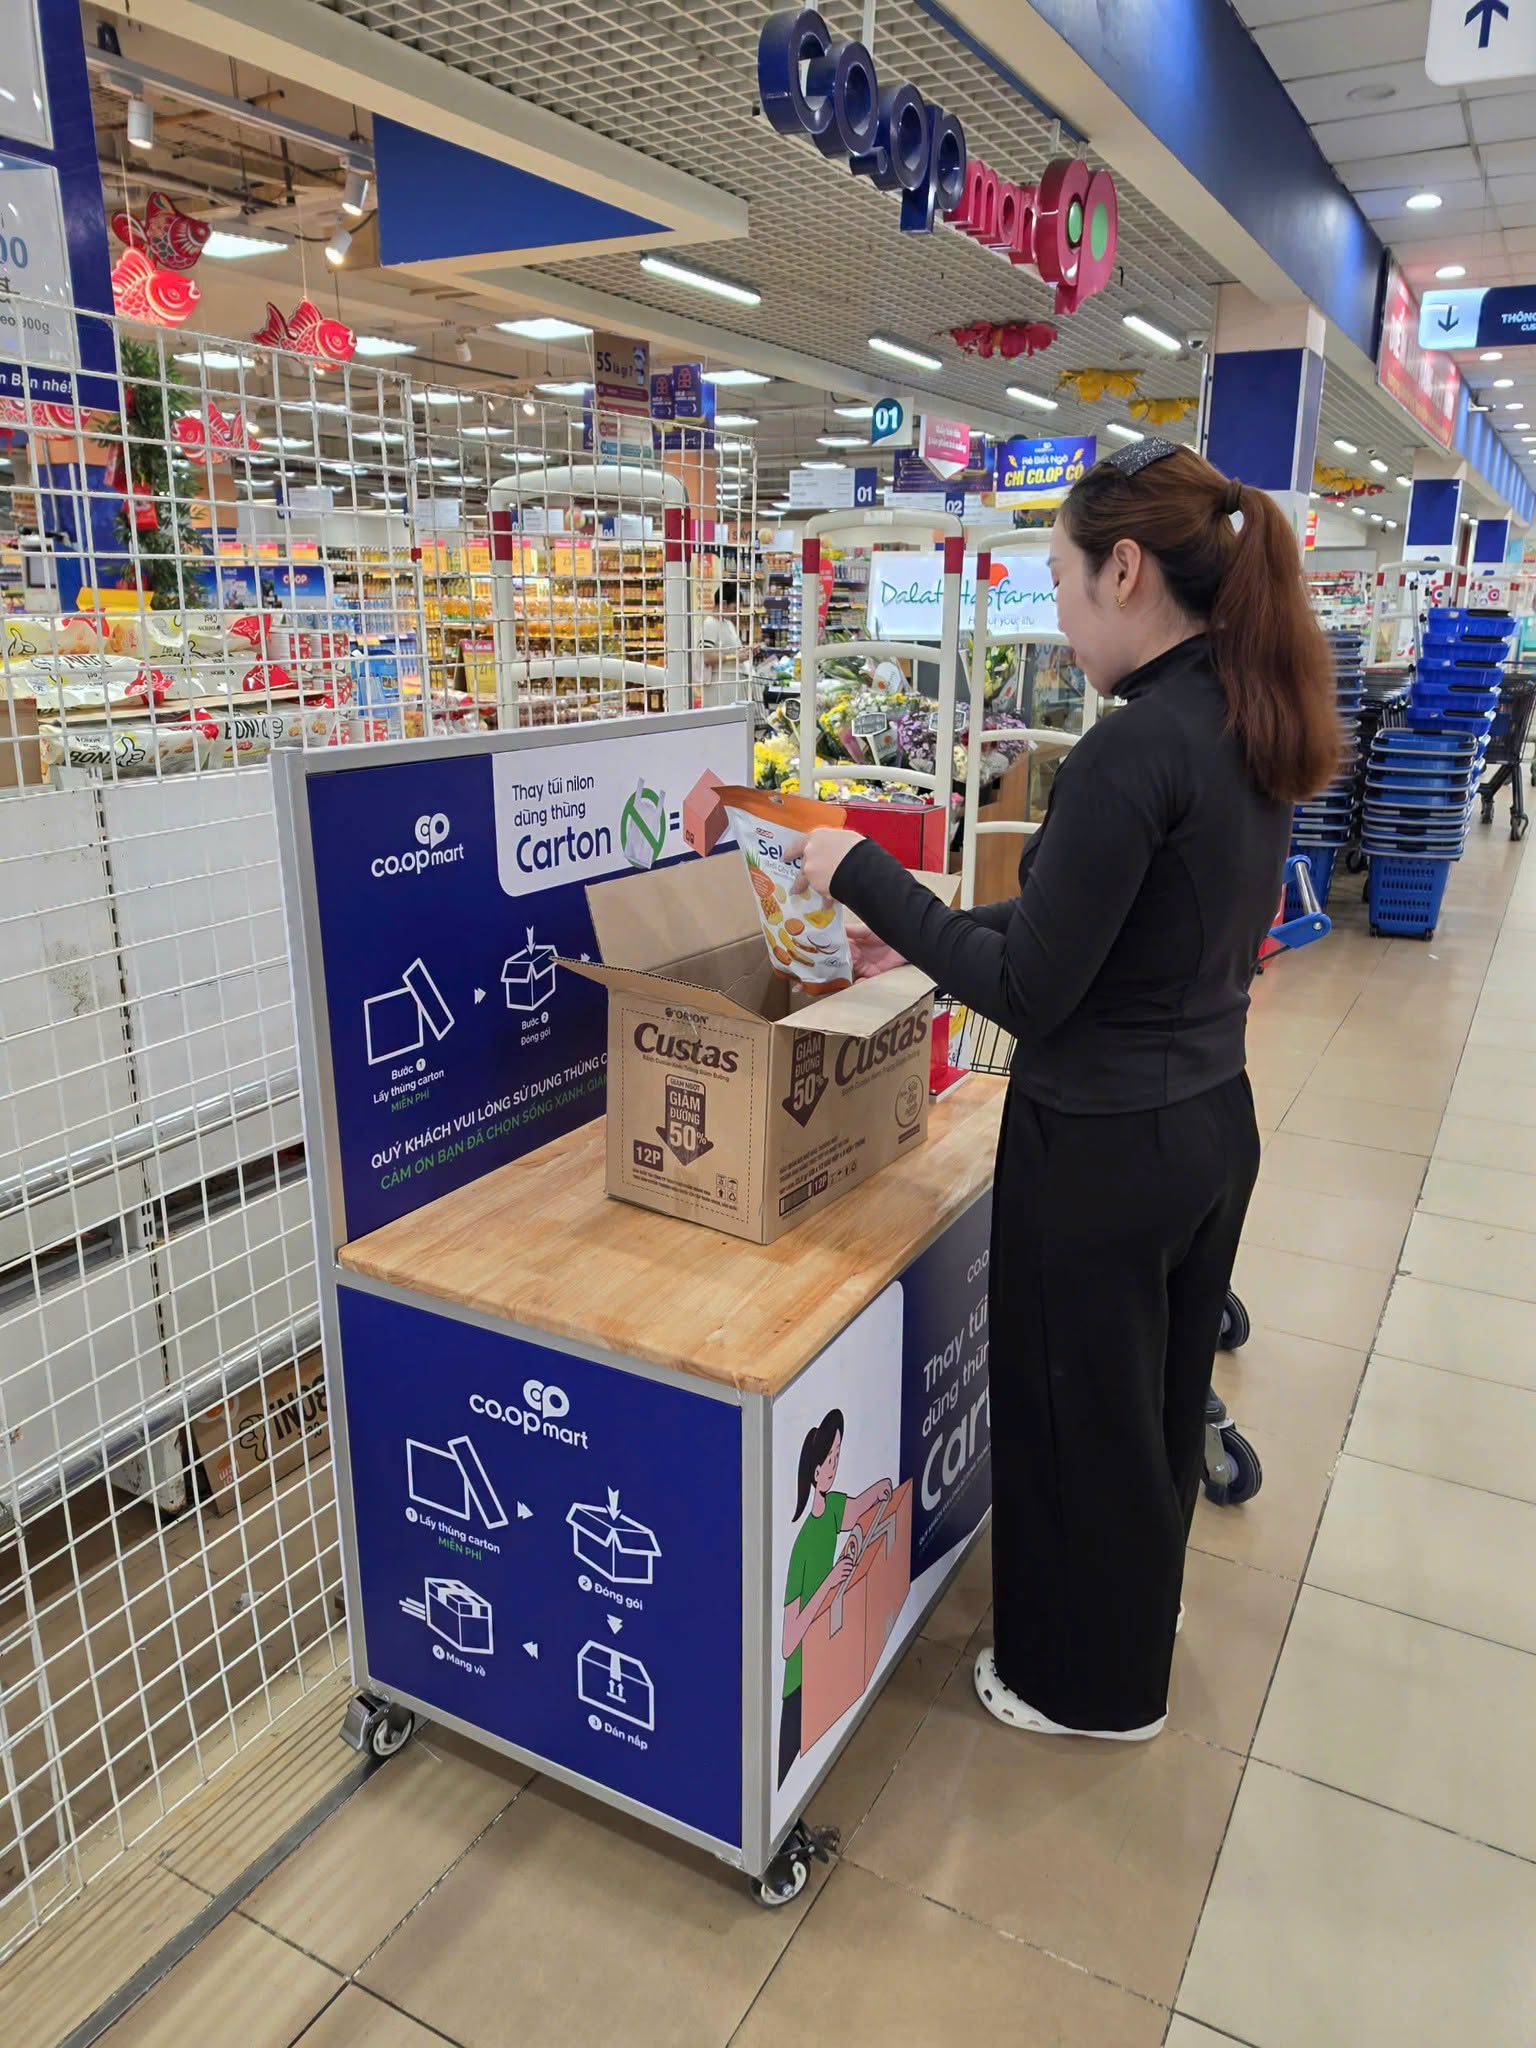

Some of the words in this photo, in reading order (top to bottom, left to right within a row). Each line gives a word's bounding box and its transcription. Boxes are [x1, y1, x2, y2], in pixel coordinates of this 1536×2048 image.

[11, 375, 39, 389] Bn
[42, 380, 73, 394] nhé!
[875, 408, 899, 430] 01
[1004, 465, 1027, 488] CHỈ
[1026, 466, 1064, 486] CO.OP
[1065, 460, 1085, 481] CÓ
[857, 486, 872, 503] 01
[946, 500, 963, 515] 02
[881, 578, 943, 607] Dalat
[512, 784, 544, 802] Thay
[548, 778, 563, 795] túi
[566, 775, 595, 793] nilon
[514, 808, 547, 827] dùng
[551, 801, 586, 820] thùng
[516, 826, 611, 873] Carton
[522, 1018, 540, 1030] Bước
[675, 1010, 707, 1025] ORION
[520, 1032, 539, 1046] Đóng
[540, 1027, 551, 1040] gói
[634, 1022, 739, 1073] Custas
[835, 1009, 929, 1086] Custas
[373, 1088, 389, 1104] Lấy
[391, 1080, 417, 1097] thùng
[417, 1069, 445, 1086] carton
[391, 1065, 414, 1080] Bước
[669, 1090, 700, 1113] GIẢM
[793, 1072, 825, 1112] 50%
[371, 1141, 402, 1169] QUÝ
[405, 1121, 452, 1155] KHÁCH
[454, 1111, 475, 1132] VUI
[478, 1096, 511, 1121] LÒNG
[513, 1084, 530, 1105] SỬ
[531, 1073, 562, 1097] DỤNG
[564, 1056, 599, 1082] THÙNG
[670, 1107, 701, 1125] ĐƯỜNG
[669, 1120, 707, 1152] 50%
[380, 1164, 412, 1190] CẢM
[414, 1153, 435, 1174] ƠN
[438, 1140, 464, 1163] BẠN
[467, 1129, 484, 1150] ĐÃ
[486, 1114, 520, 1140] CHỌN
[636, 1145, 661, 1165] 12P
[924, 1328, 964, 1392] Thay
[969, 1293, 989, 1339] túi
[922, 1378, 960, 1438] dùng
[420, 1514, 437, 1530] Lấy
[468, 1535, 500, 1554] carton
[594, 1583, 624, 1605] Đóng
[625, 1595, 643, 1611] gói
[446, 1651, 473, 1673] Mang
[604, 1722, 626, 1740] Dán
[627, 1730, 648, 1751] nắp
